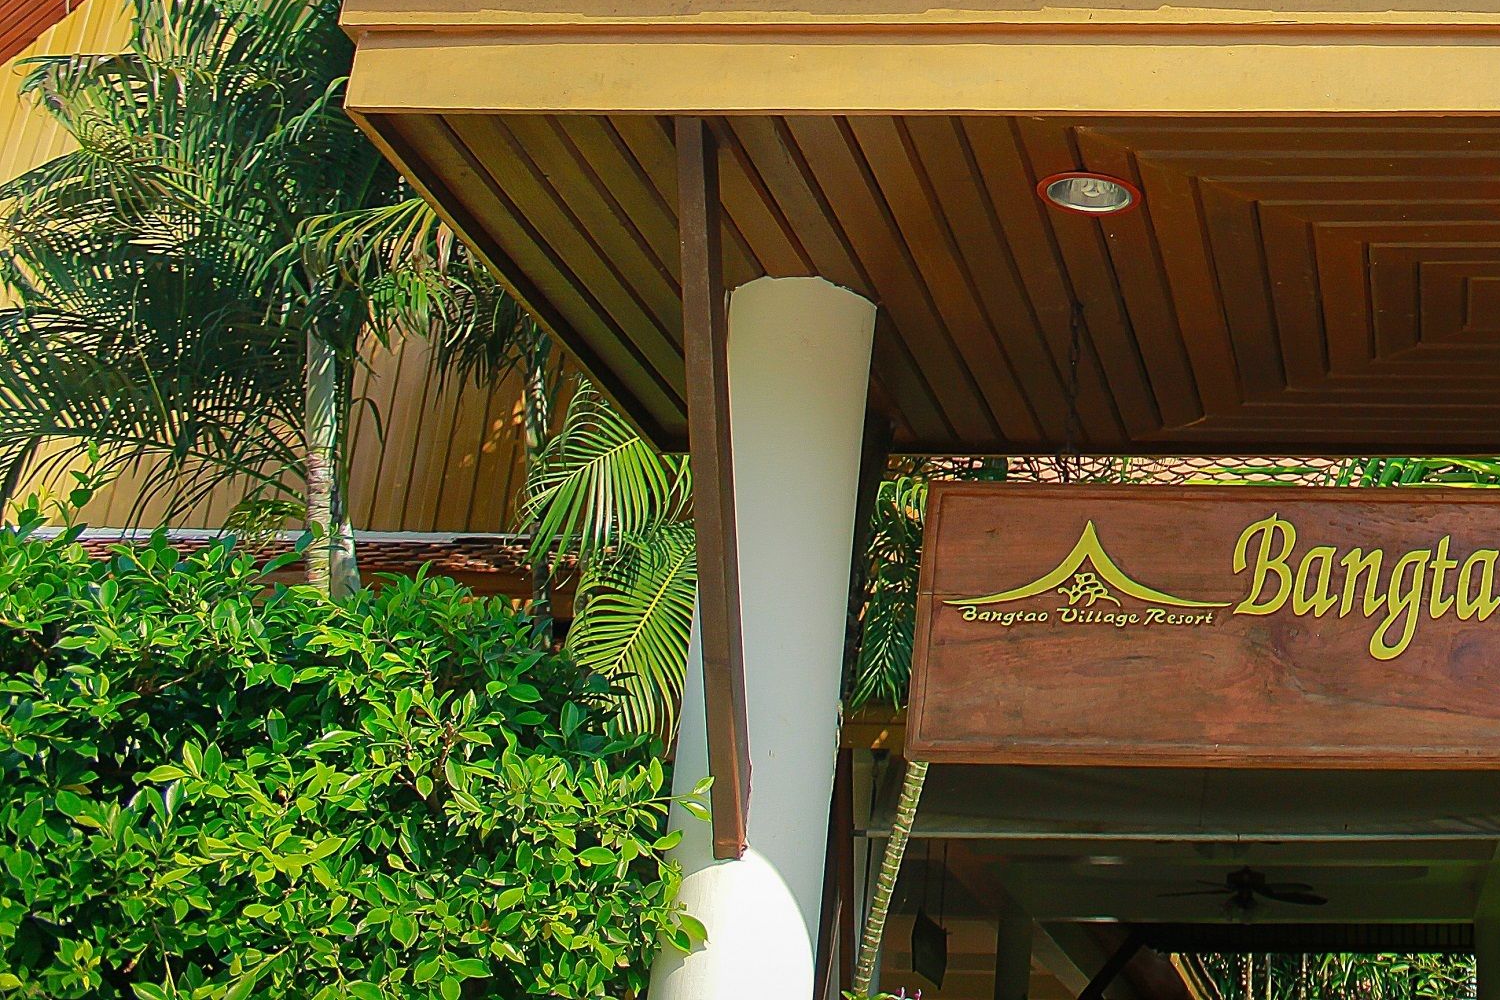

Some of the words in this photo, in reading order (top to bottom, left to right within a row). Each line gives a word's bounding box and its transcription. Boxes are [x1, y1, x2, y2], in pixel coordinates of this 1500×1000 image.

[957, 605, 1048, 626] Bangtao
[1056, 607, 1140, 627] Village
[1143, 608, 1213, 626] Resort
